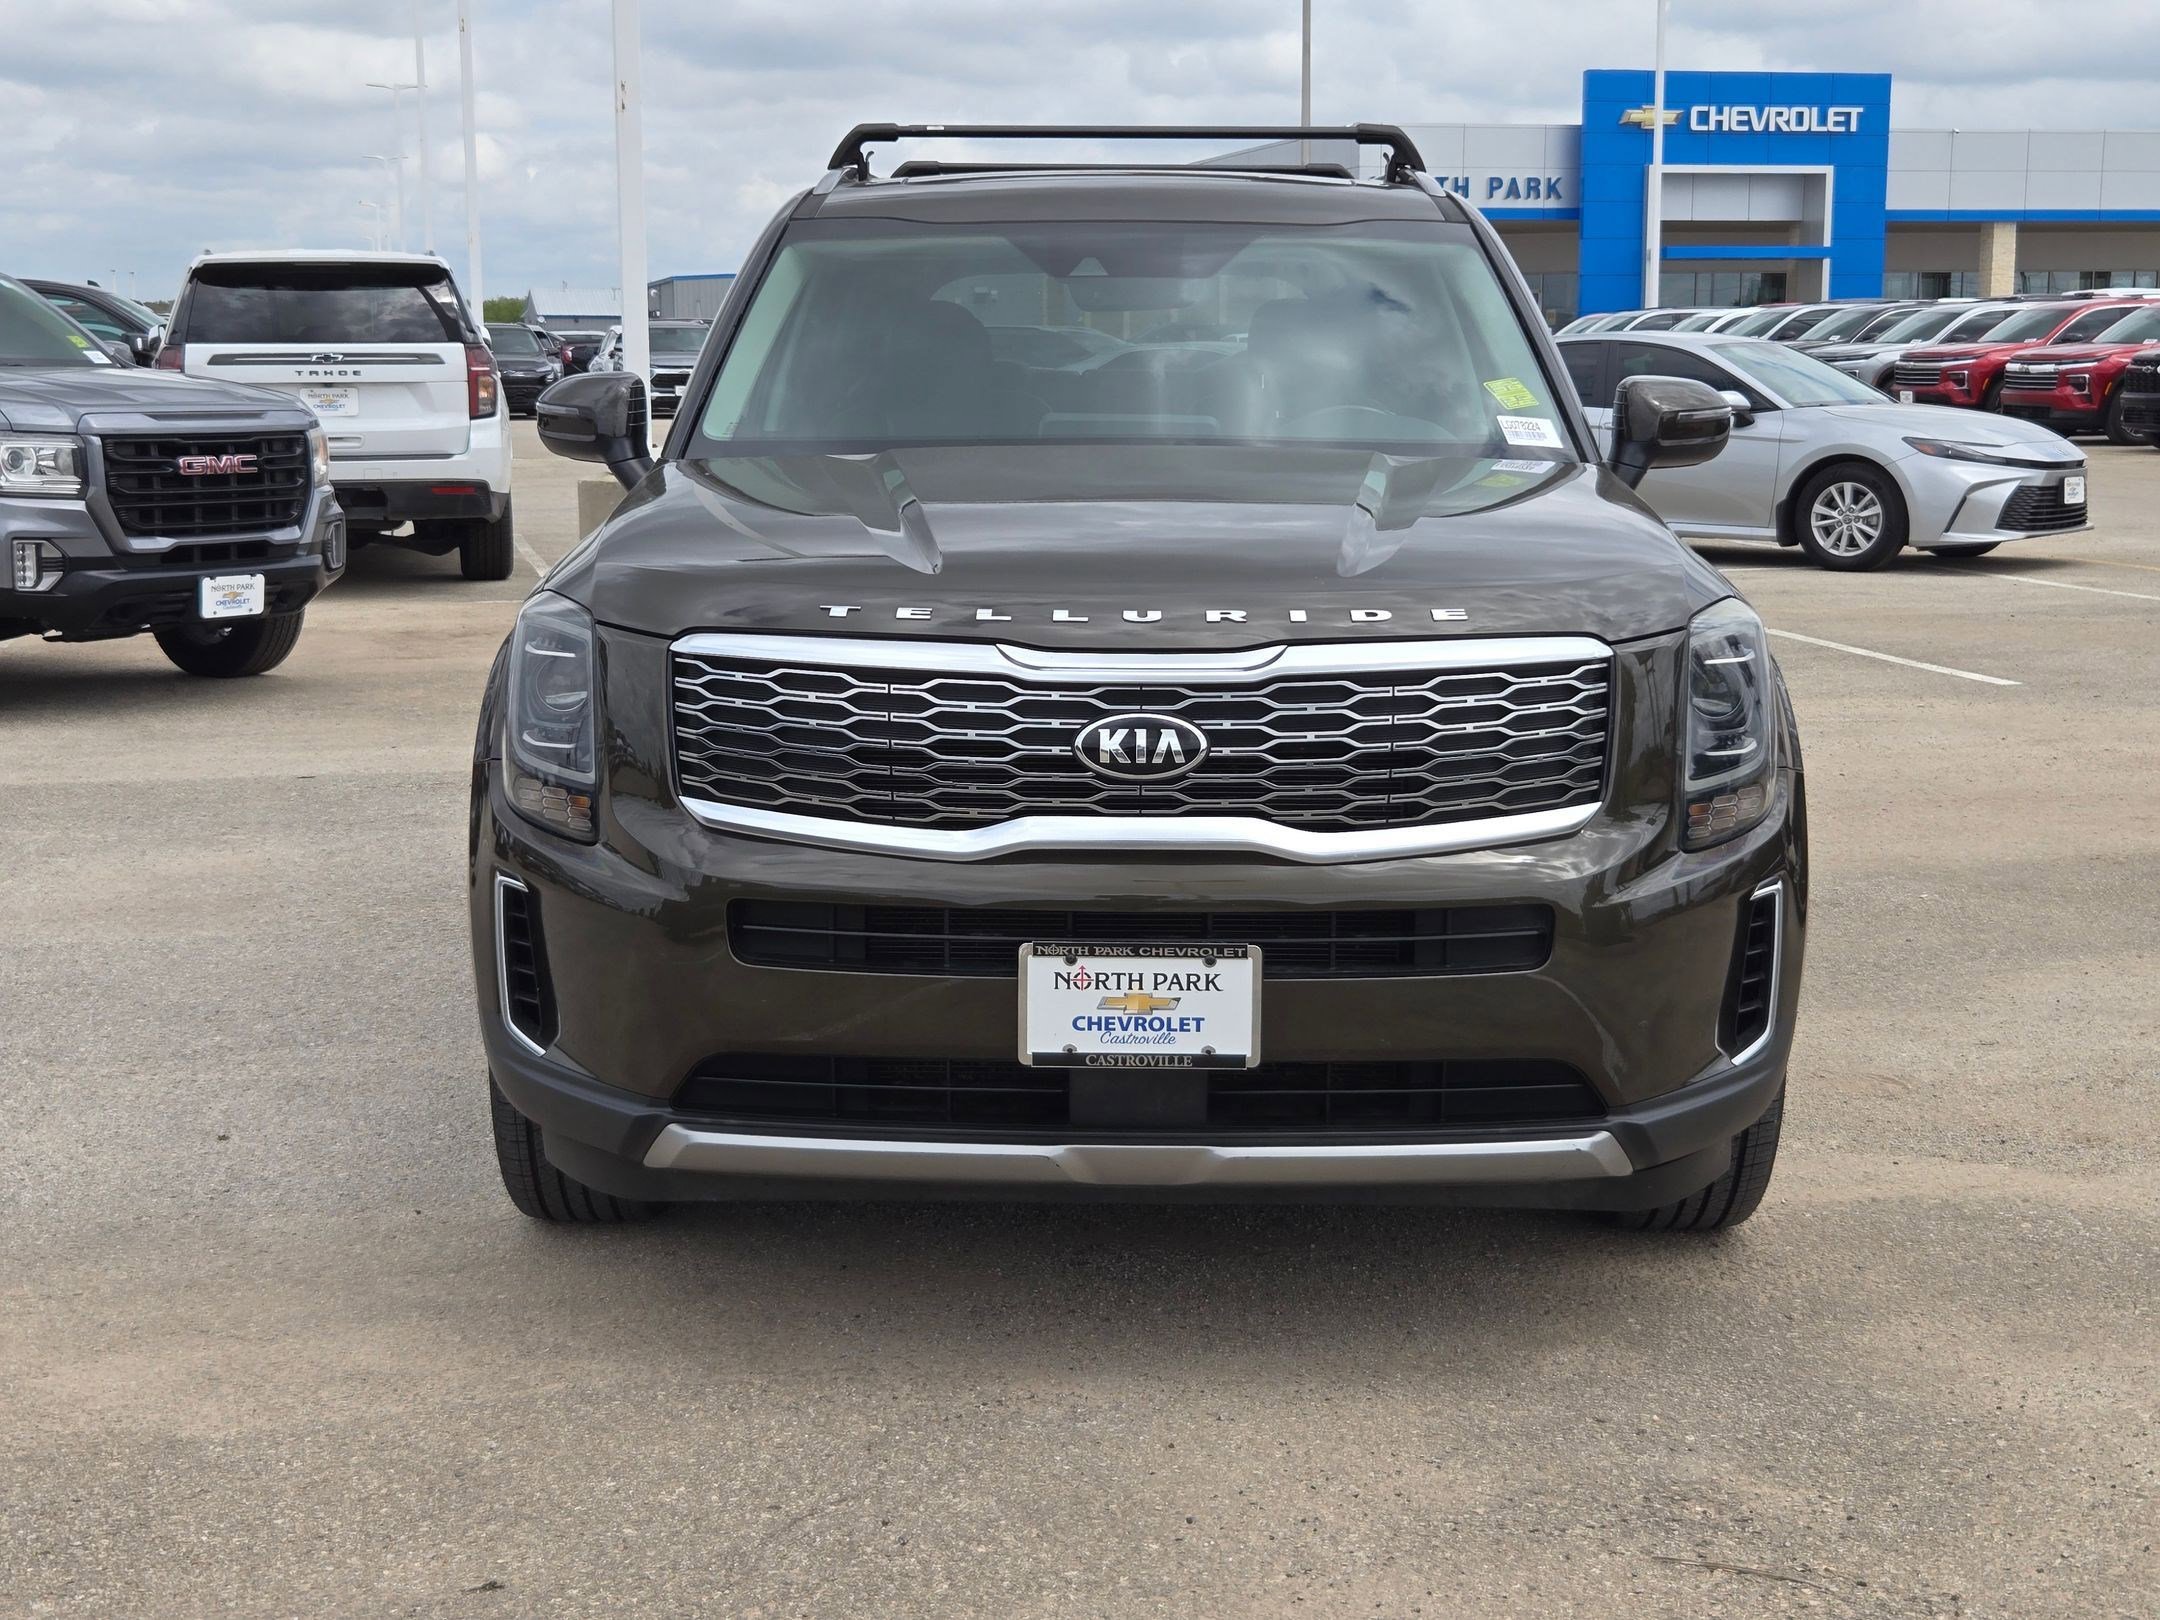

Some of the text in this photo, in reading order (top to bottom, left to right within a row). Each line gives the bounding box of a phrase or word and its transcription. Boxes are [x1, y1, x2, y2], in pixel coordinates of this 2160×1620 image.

[1690, 105, 1864, 132] CHEVROLET
[1487, 176, 1563, 200] PARK
[179, 454, 259, 475] GMC
[211, 583, 256, 592] NORTH PARK
[215, 598, 251, 607] CHEVROLET
[820, 604, 1469, 623] TELLURIDE
[1098, 728, 1186, 764] KIA
[1035, 944, 1246, 958] NORTH PARK CHEVROLET
[1053, 968, 1224, 992] NORTH PARK
[1071, 1015, 1206, 1033] CHEVROLET
[1100, 1030, 1177, 1046] Castroville
[1085, 1053, 1194, 1068] CASTROVILLE
